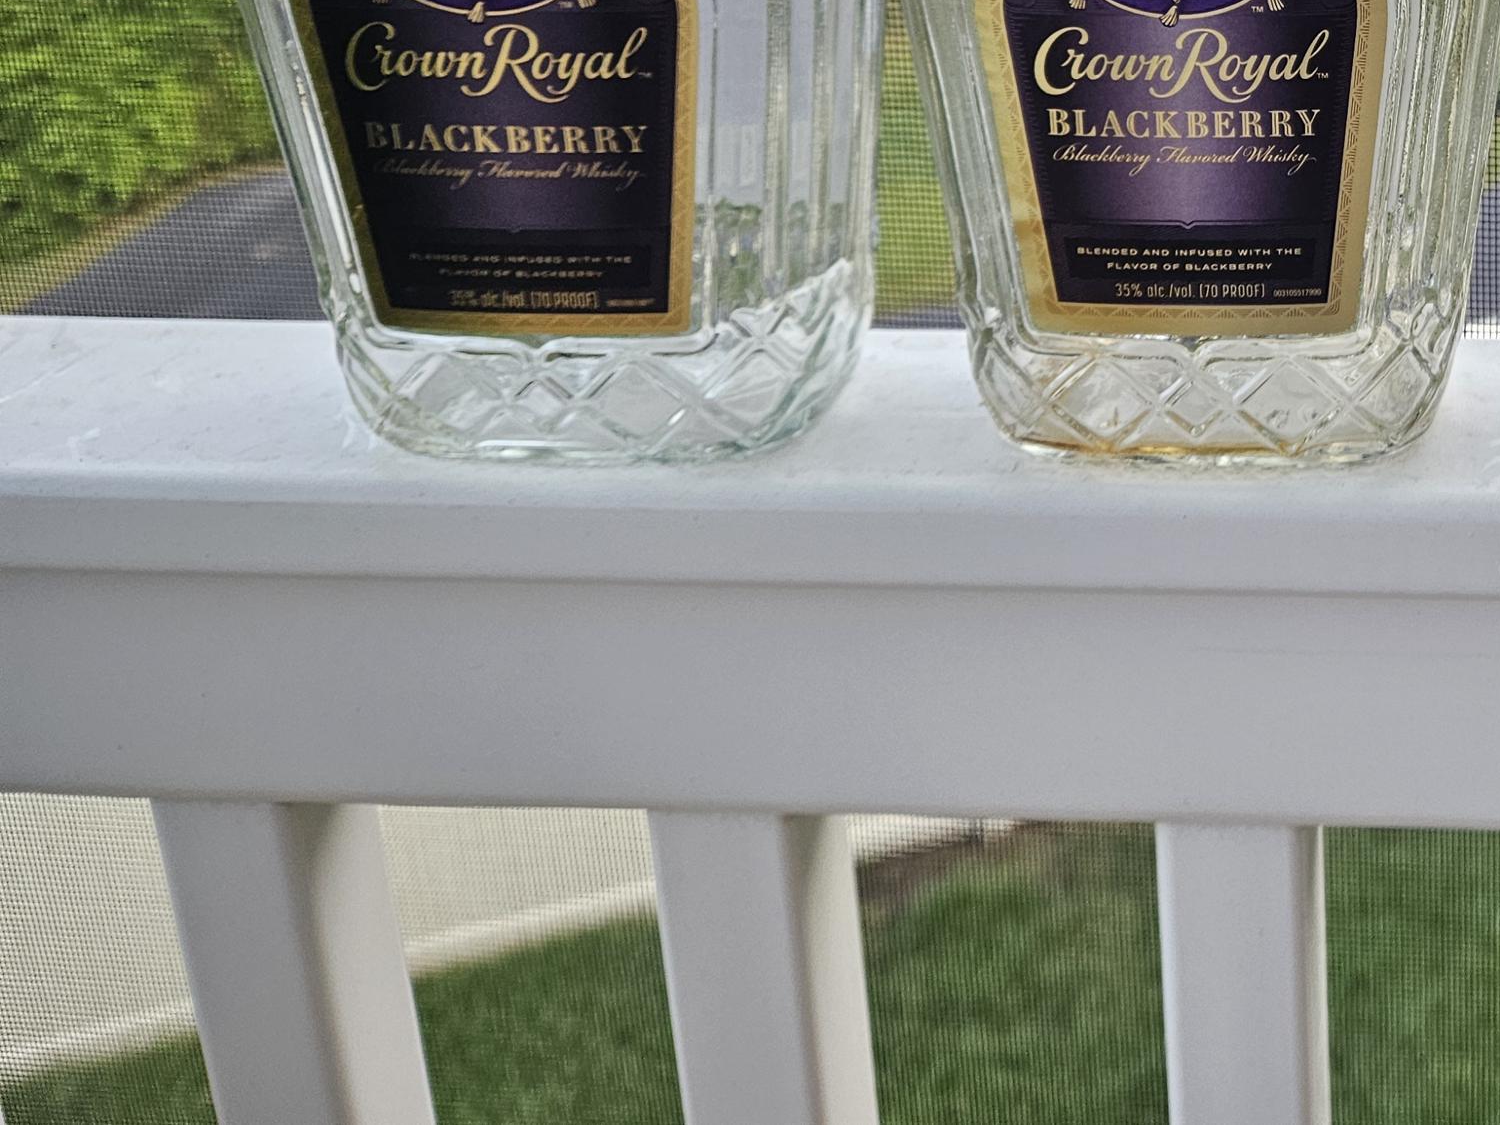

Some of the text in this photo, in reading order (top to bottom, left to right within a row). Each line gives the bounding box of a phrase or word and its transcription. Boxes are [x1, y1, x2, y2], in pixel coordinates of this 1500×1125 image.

[345, 21, 648, 104] Crown Royal
[1034, 26, 1175, 96] Crown
[1149, 27, 1329, 104] Royal
[365, 121, 647, 154] BLACKBERRY
[1047, 108, 1320, 139] BLACKBERRY
[1053, 144, 1317, 176] Blackberry Flavored Whisky
[1077, 247, 1138, 256] BLENDED
[1143, 248, 1169, 256] AND
[1175, 249, 1232, 257] INFUSED
[1237, 248, 1271, 256] WITH
[1107, 262, 1272, 271] FLAVOR OF BLACKBERRY
[1114, 283, 1143, 298] 35%
